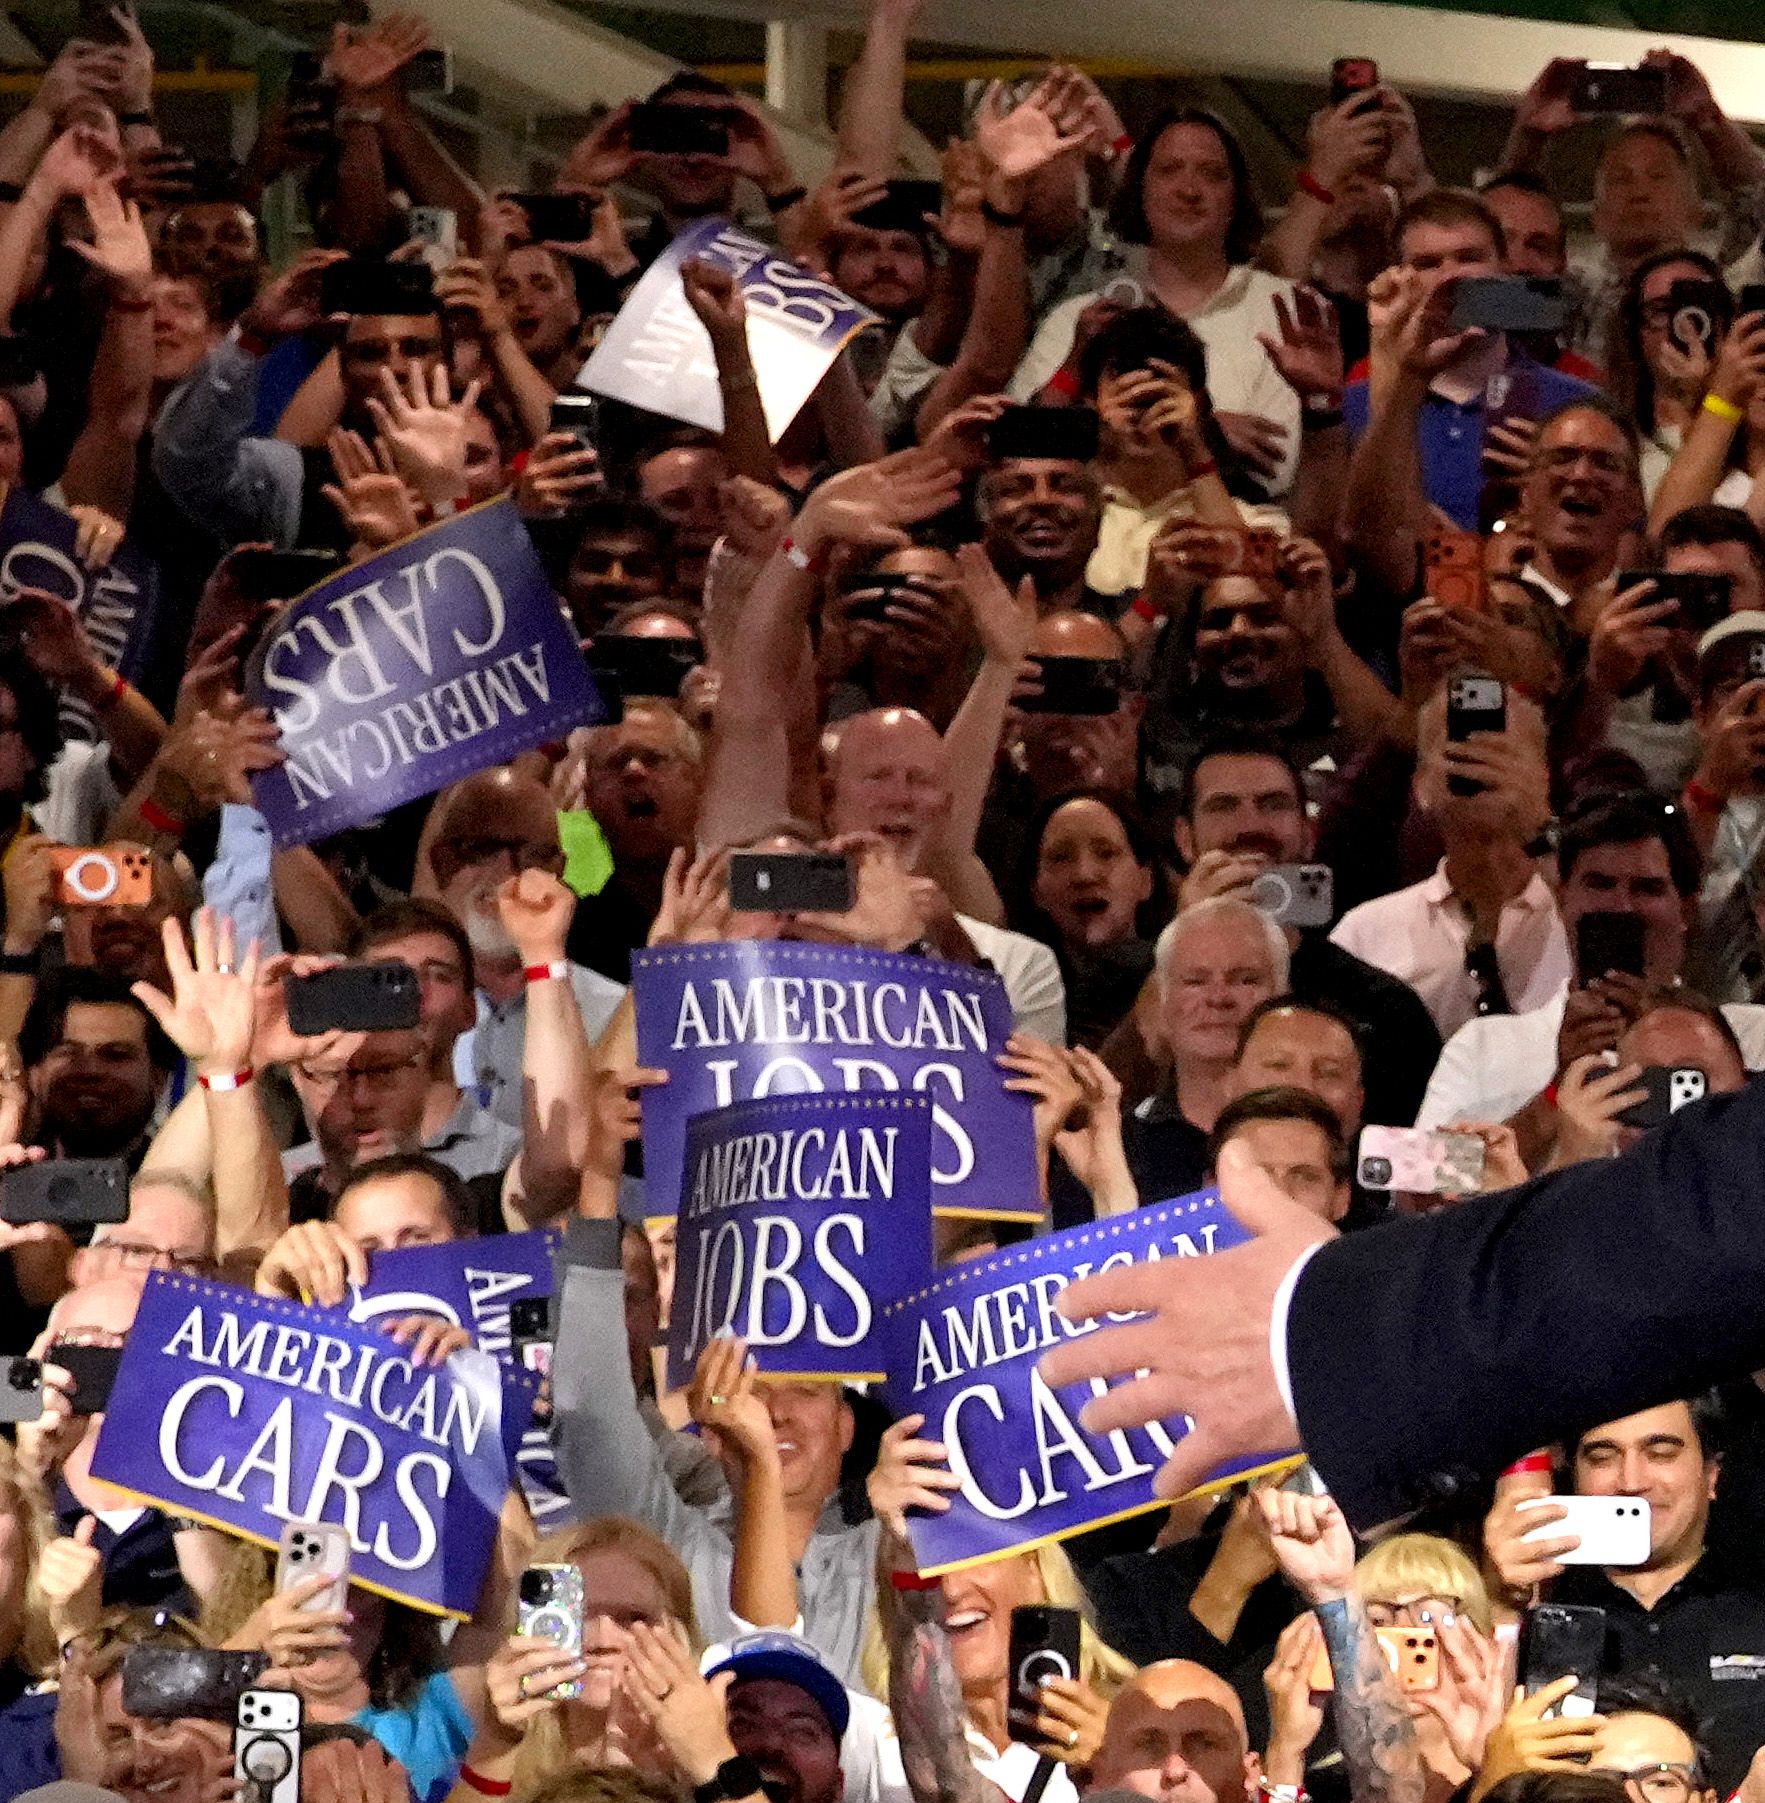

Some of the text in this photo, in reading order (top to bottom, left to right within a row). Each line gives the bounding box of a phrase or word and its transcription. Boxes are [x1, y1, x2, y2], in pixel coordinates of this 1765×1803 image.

[262, 547, 506, 736] CARS
[284, 642, 552, 810] AMERICAN
[670, 976, 989, 1054] AMERICAN
[688, 1127, 899, 1219] AMERICAN
[684, 1212, 872, 1361] JOBS
[162, 1306, 488, 1456] AMERICAN
[159, 1375, 452, 1571] CARS
